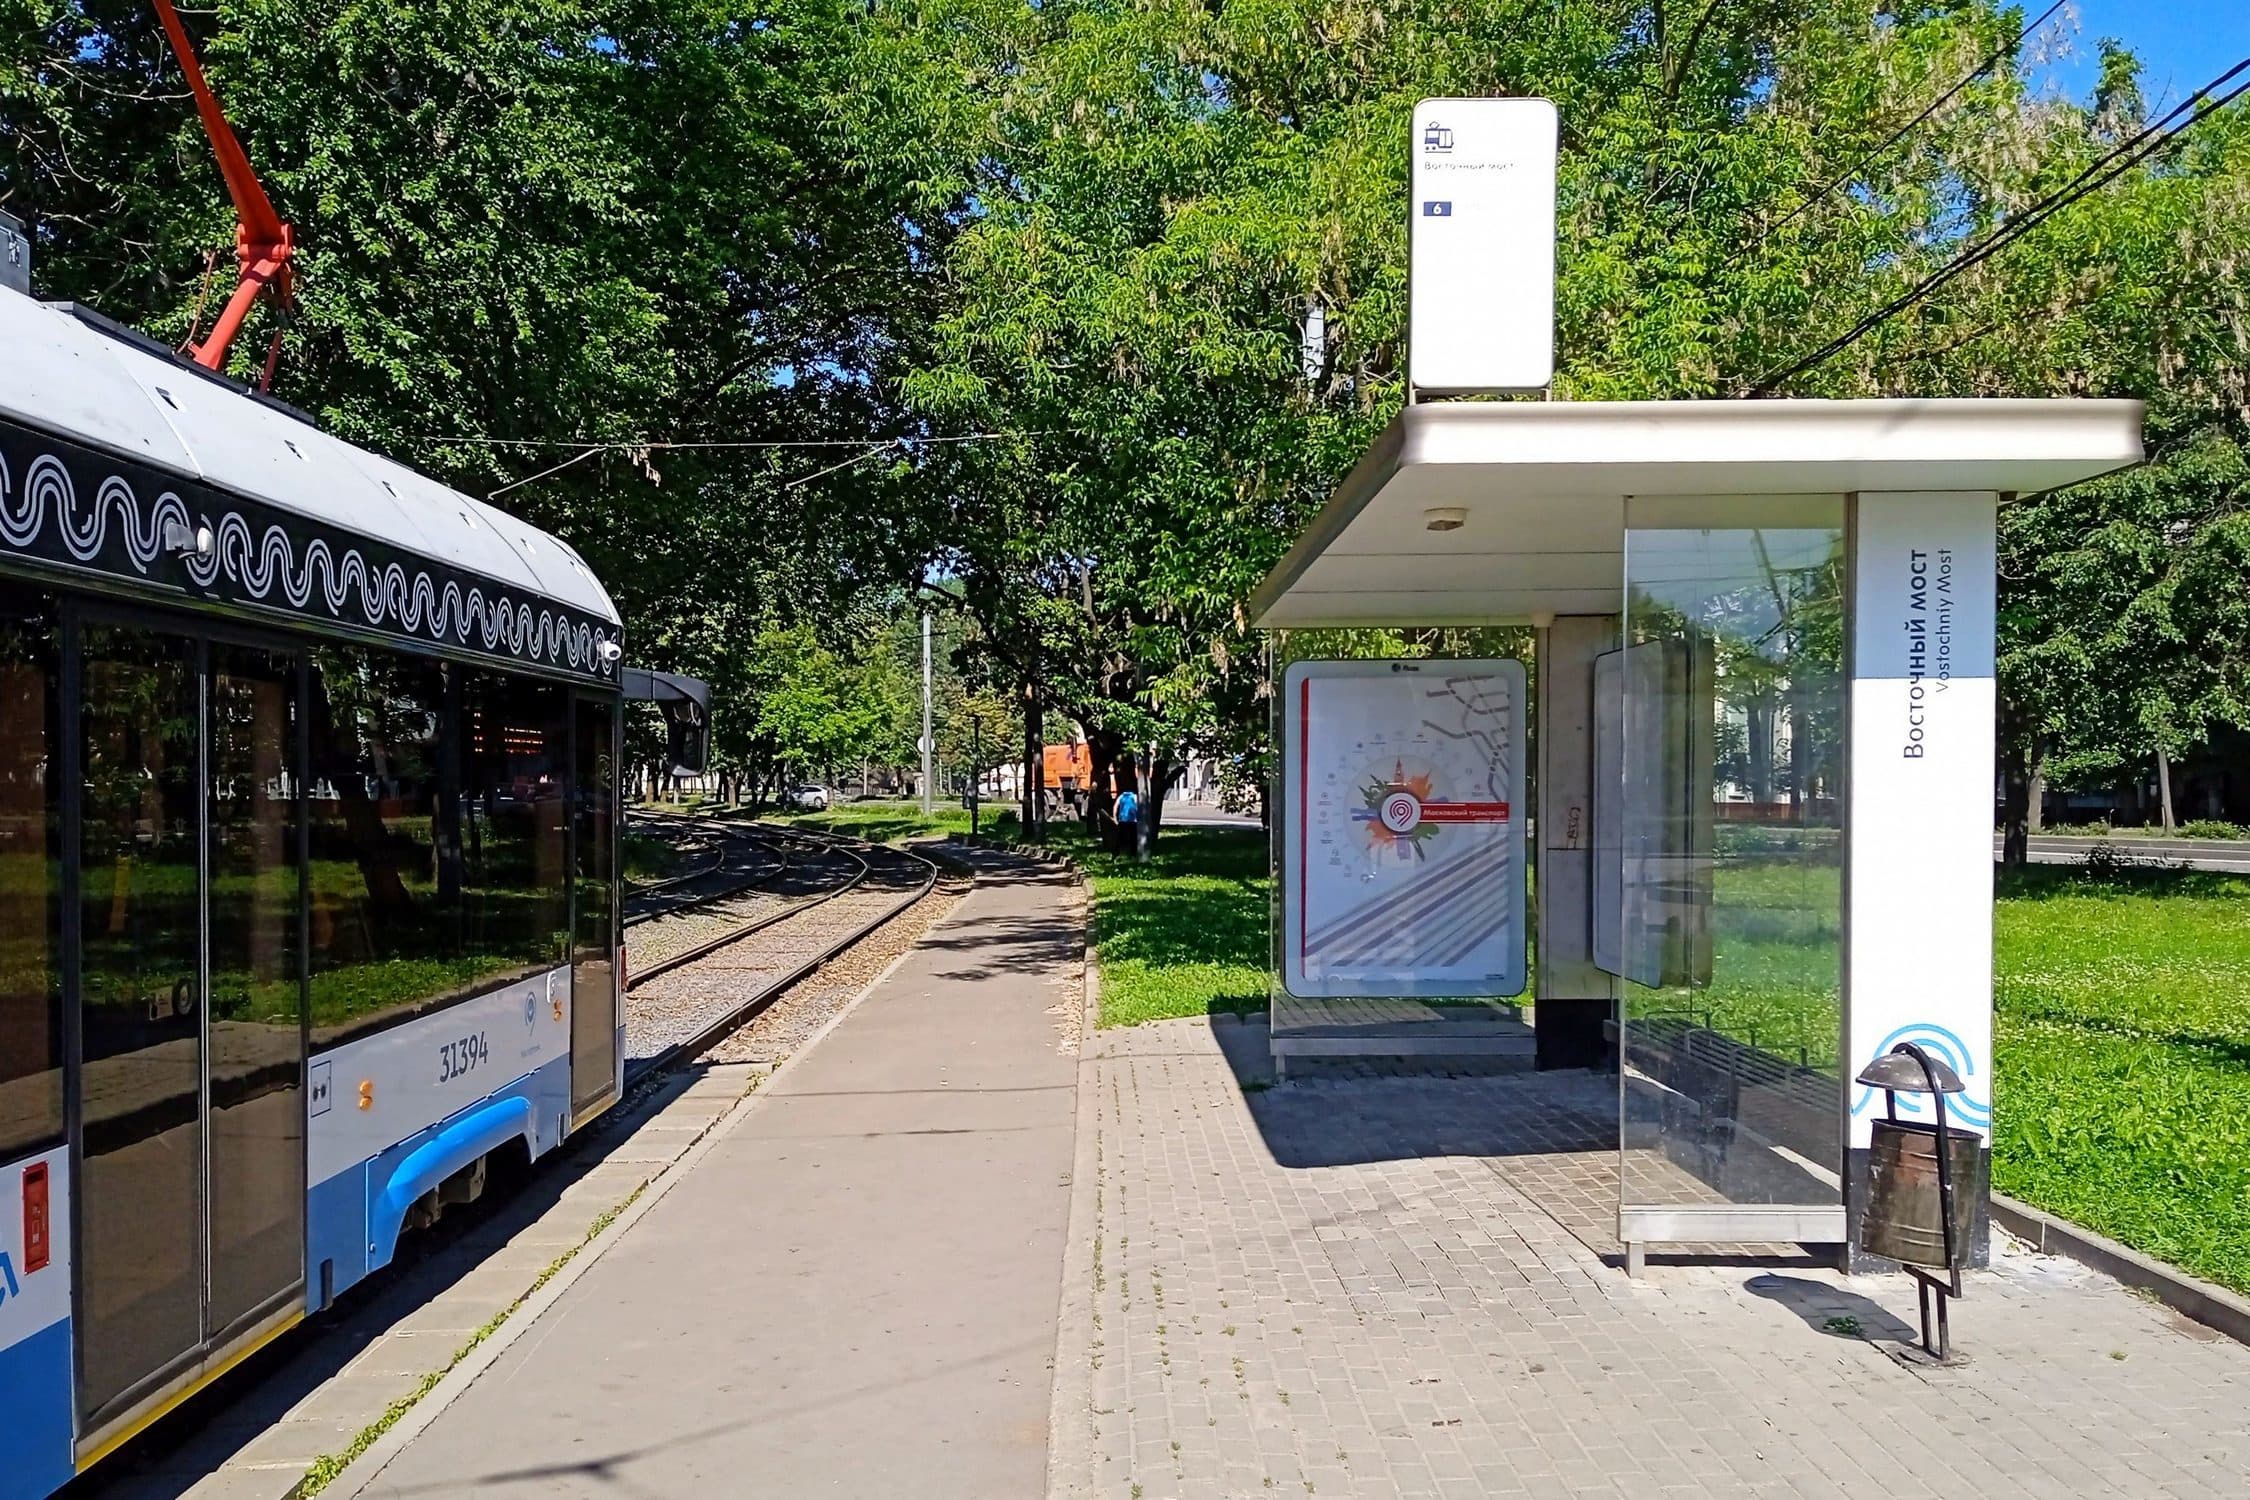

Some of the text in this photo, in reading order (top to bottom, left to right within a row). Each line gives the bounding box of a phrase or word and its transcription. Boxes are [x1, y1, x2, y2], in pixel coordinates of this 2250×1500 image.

[1432, 202, 1443, 216] 6
[1935, 548, 1954, 693] Vostochniy Most
[1904, 549, 1927, 758] Восточный мост
[1423, 808, 1468, 817] Московский
[439, 1030, 489, 1083] 31394
